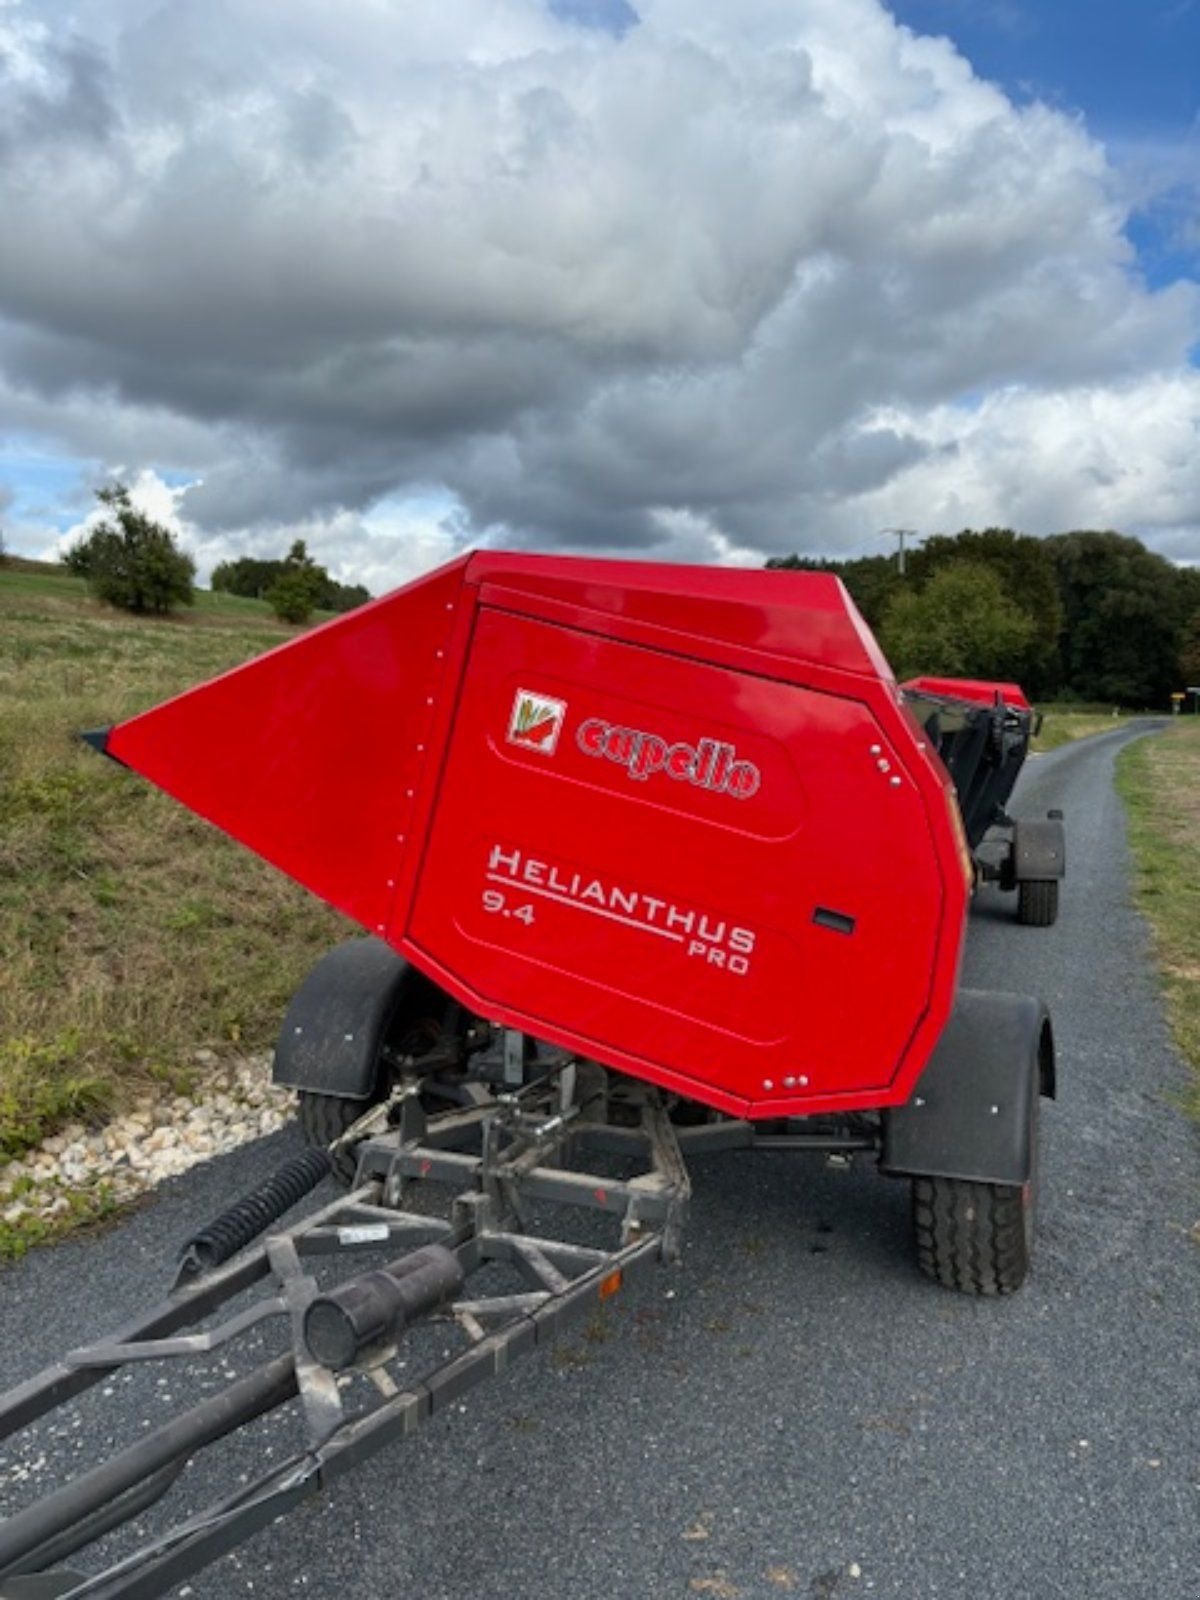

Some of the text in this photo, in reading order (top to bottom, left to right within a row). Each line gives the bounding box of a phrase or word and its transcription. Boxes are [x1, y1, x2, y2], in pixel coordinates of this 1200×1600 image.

[577, 718, 761, 799] capello
[482, 890, 535, 925] 9.4
[488, 845, 755, 953] HELIANTHUS
[687, 941, 748, 975] PRO
